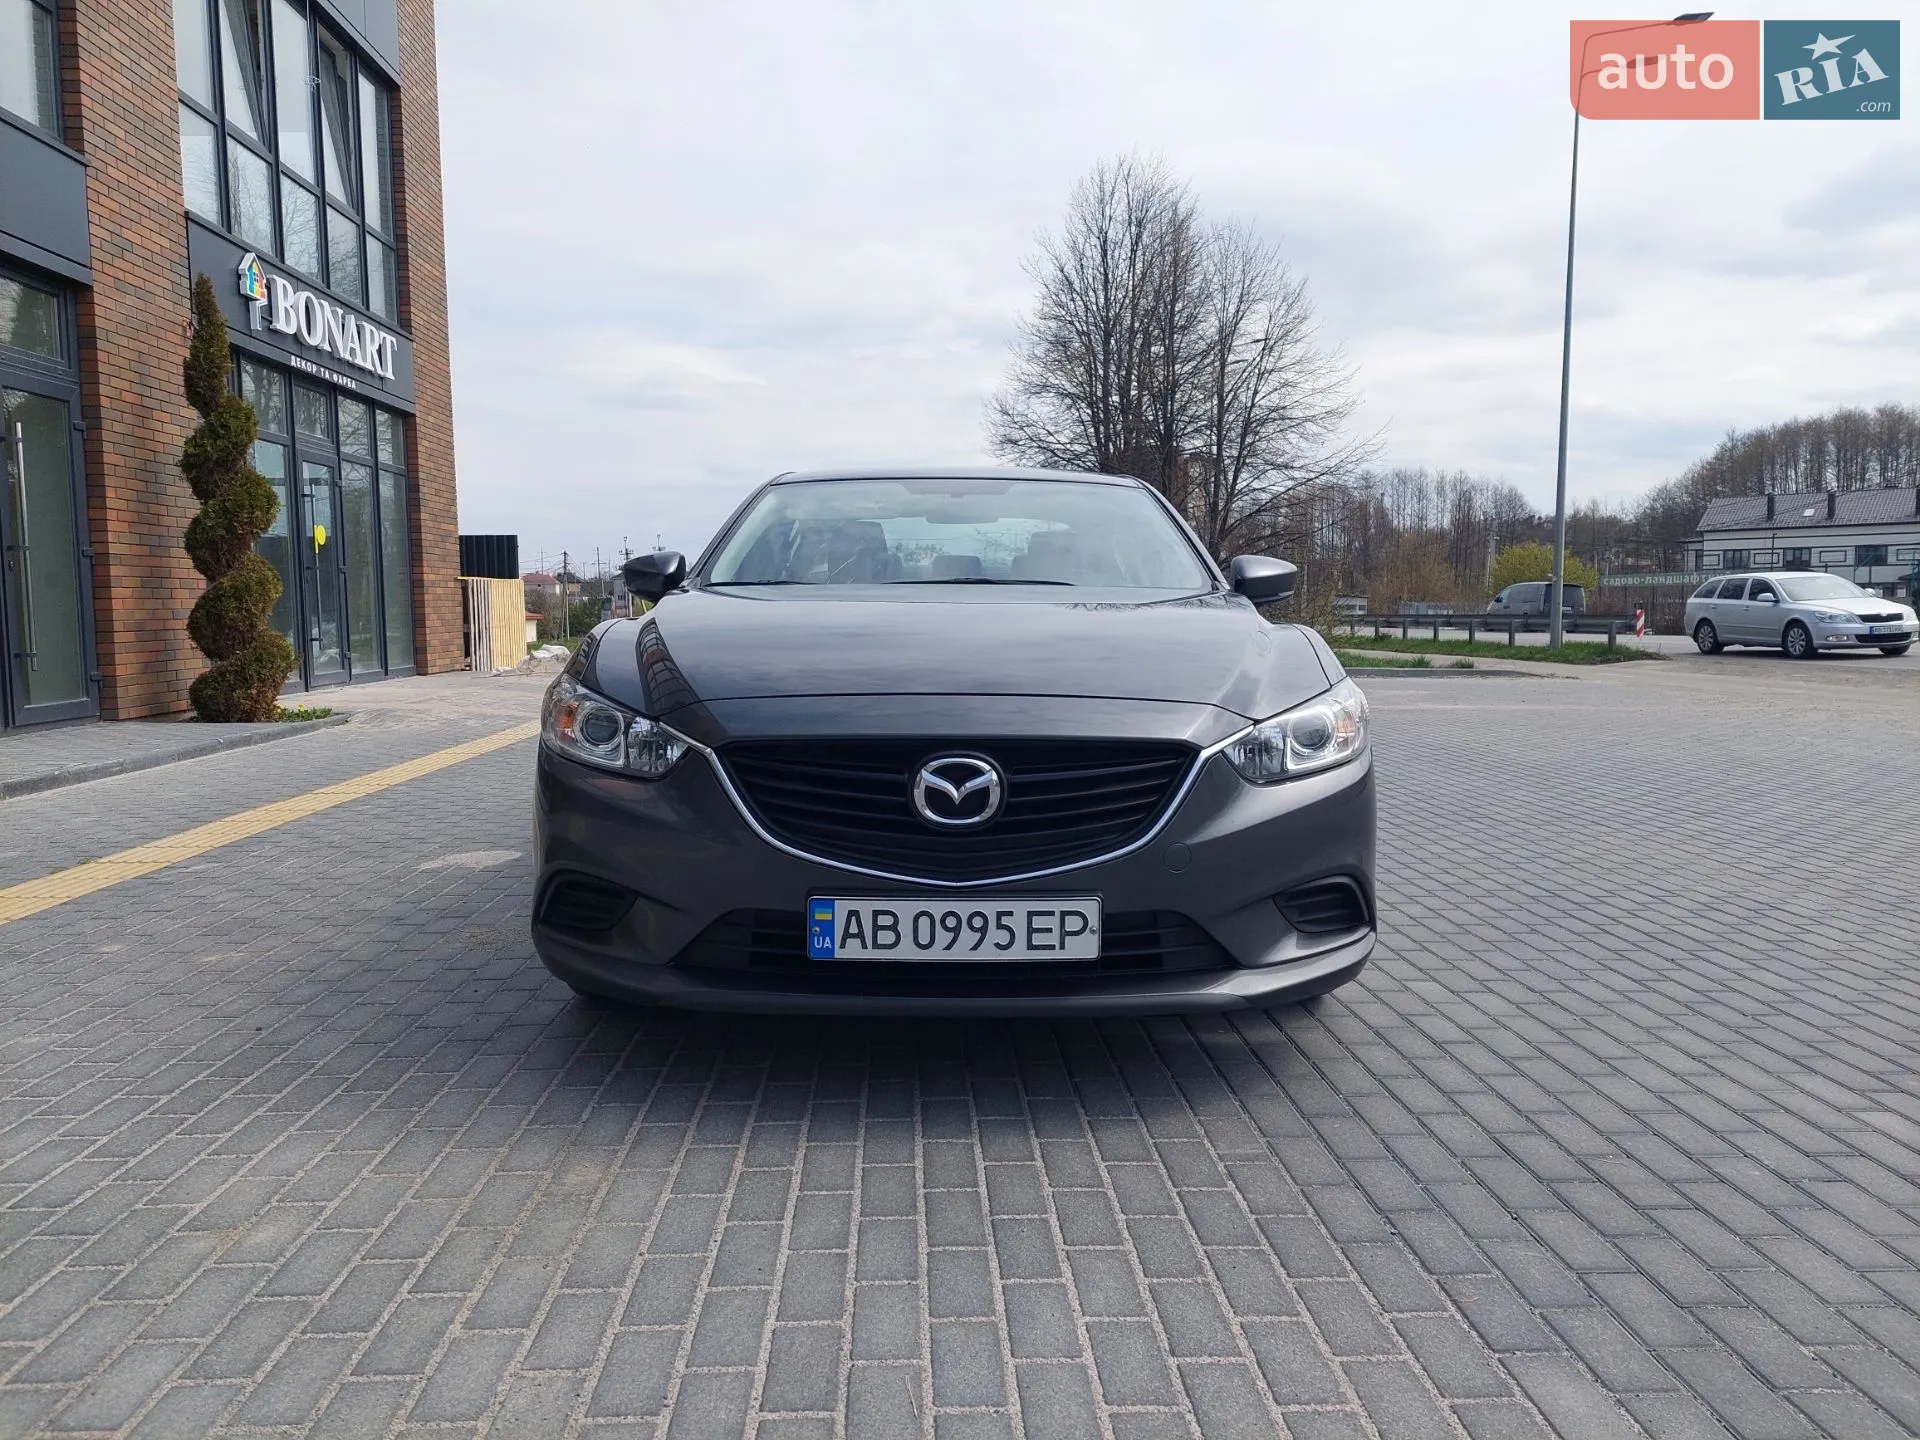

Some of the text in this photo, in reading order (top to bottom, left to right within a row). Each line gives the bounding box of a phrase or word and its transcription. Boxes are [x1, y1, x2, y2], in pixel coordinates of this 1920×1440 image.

[267, 275, 397, 380] BONART
[290, 355, 357, 389] ДЕКОР ТА ФАРБА
[814, 936, 832, 949] UA
[839, 909, 1089, 950] AB 0995 EP
